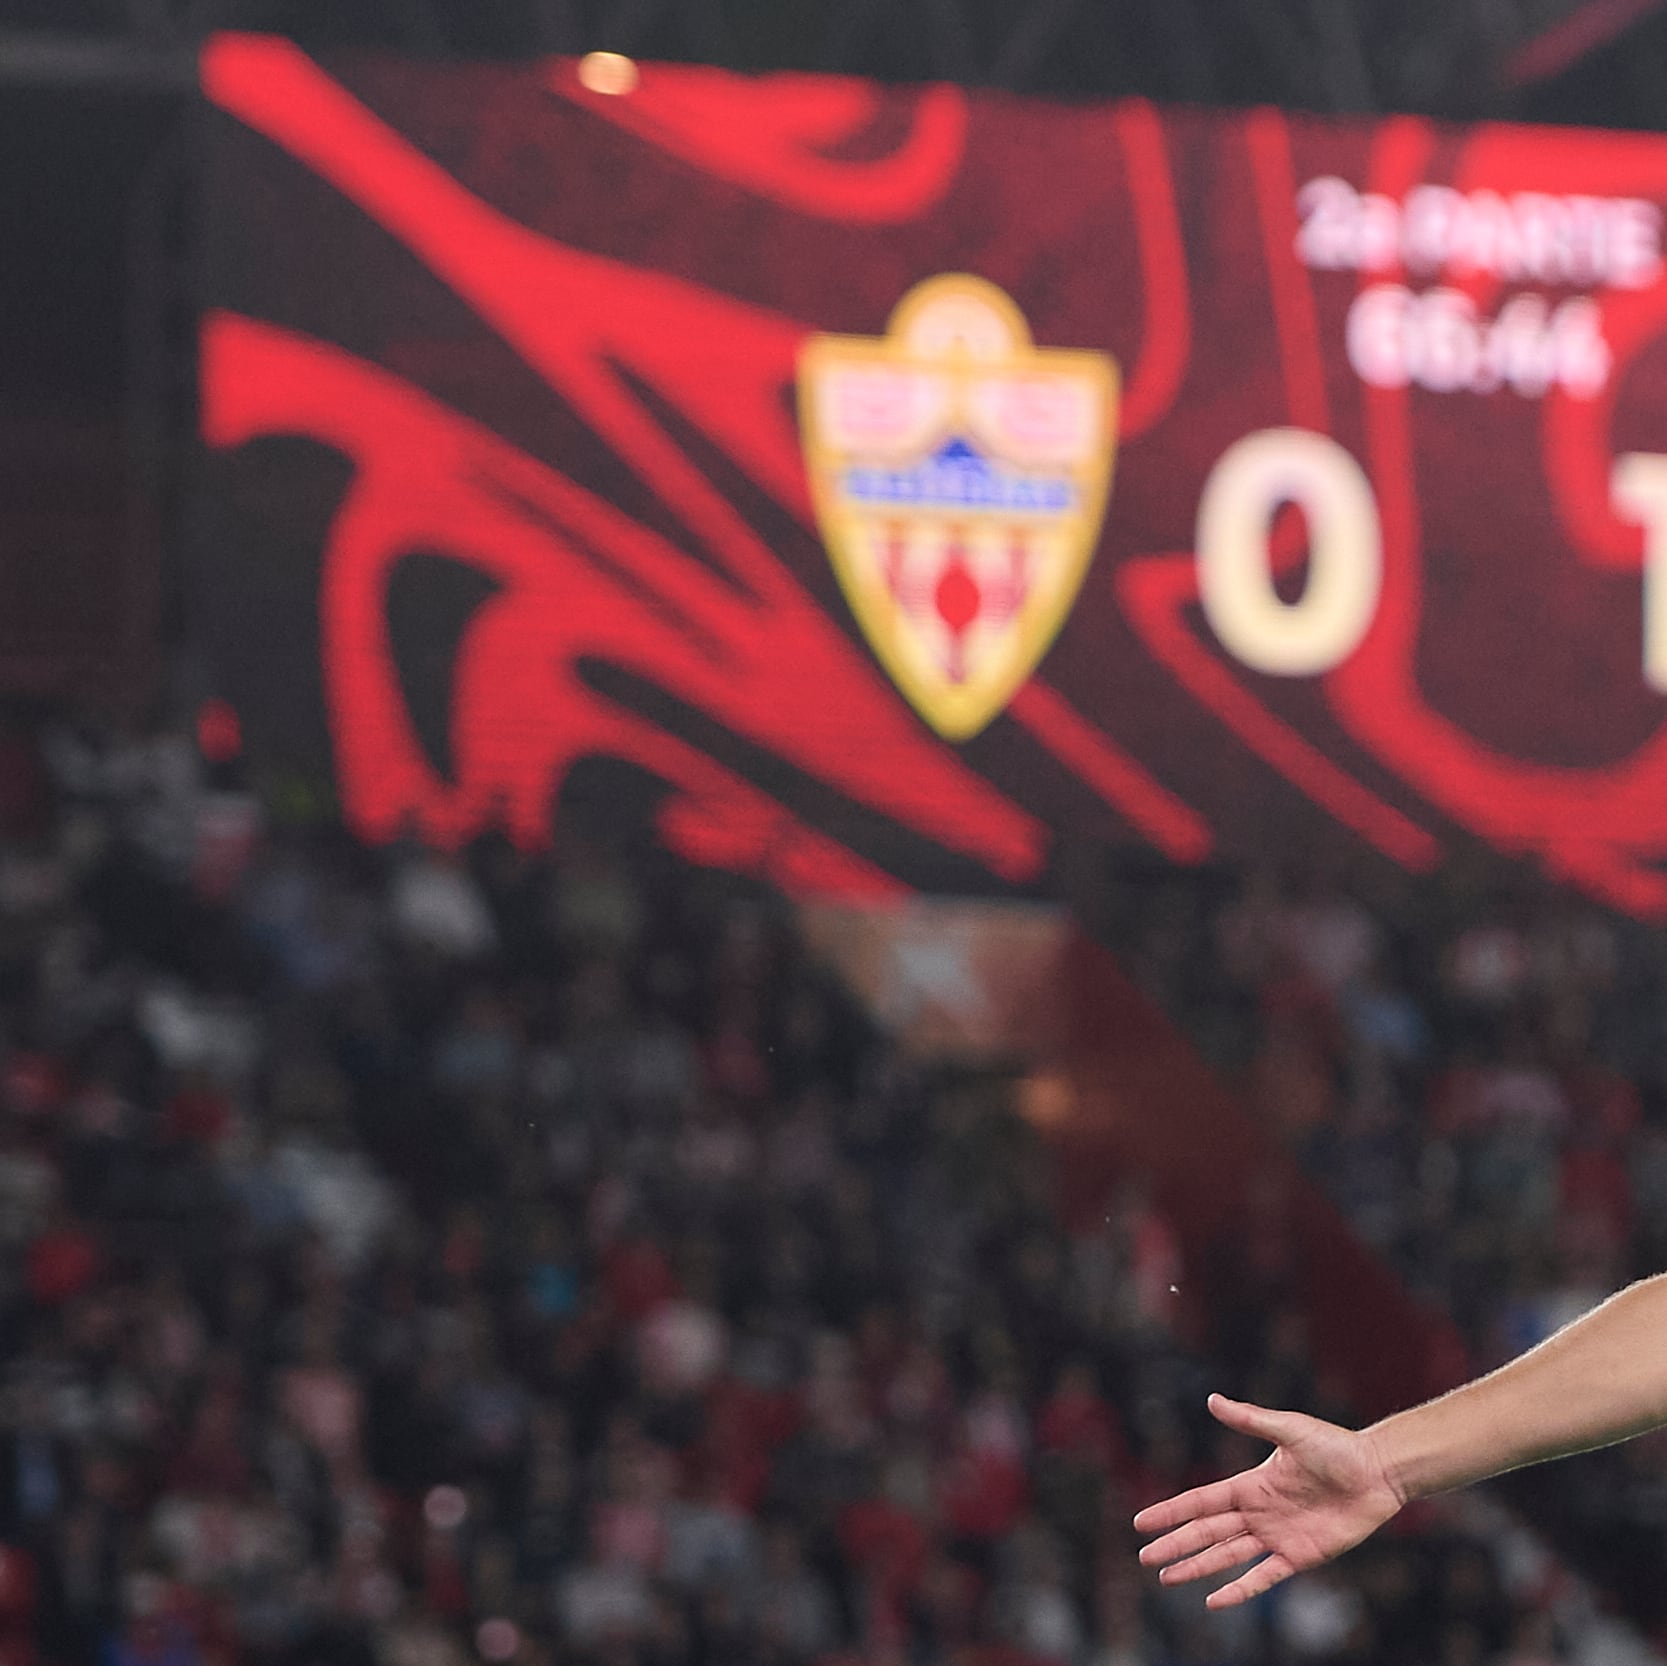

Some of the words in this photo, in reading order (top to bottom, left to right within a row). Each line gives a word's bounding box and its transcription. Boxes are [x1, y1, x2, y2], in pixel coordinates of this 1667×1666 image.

[1403, 185, 1664, 290] PARTE
[1346, 284, 1612, 400] 66:44
[1195, 425, 1383, 678] 0
